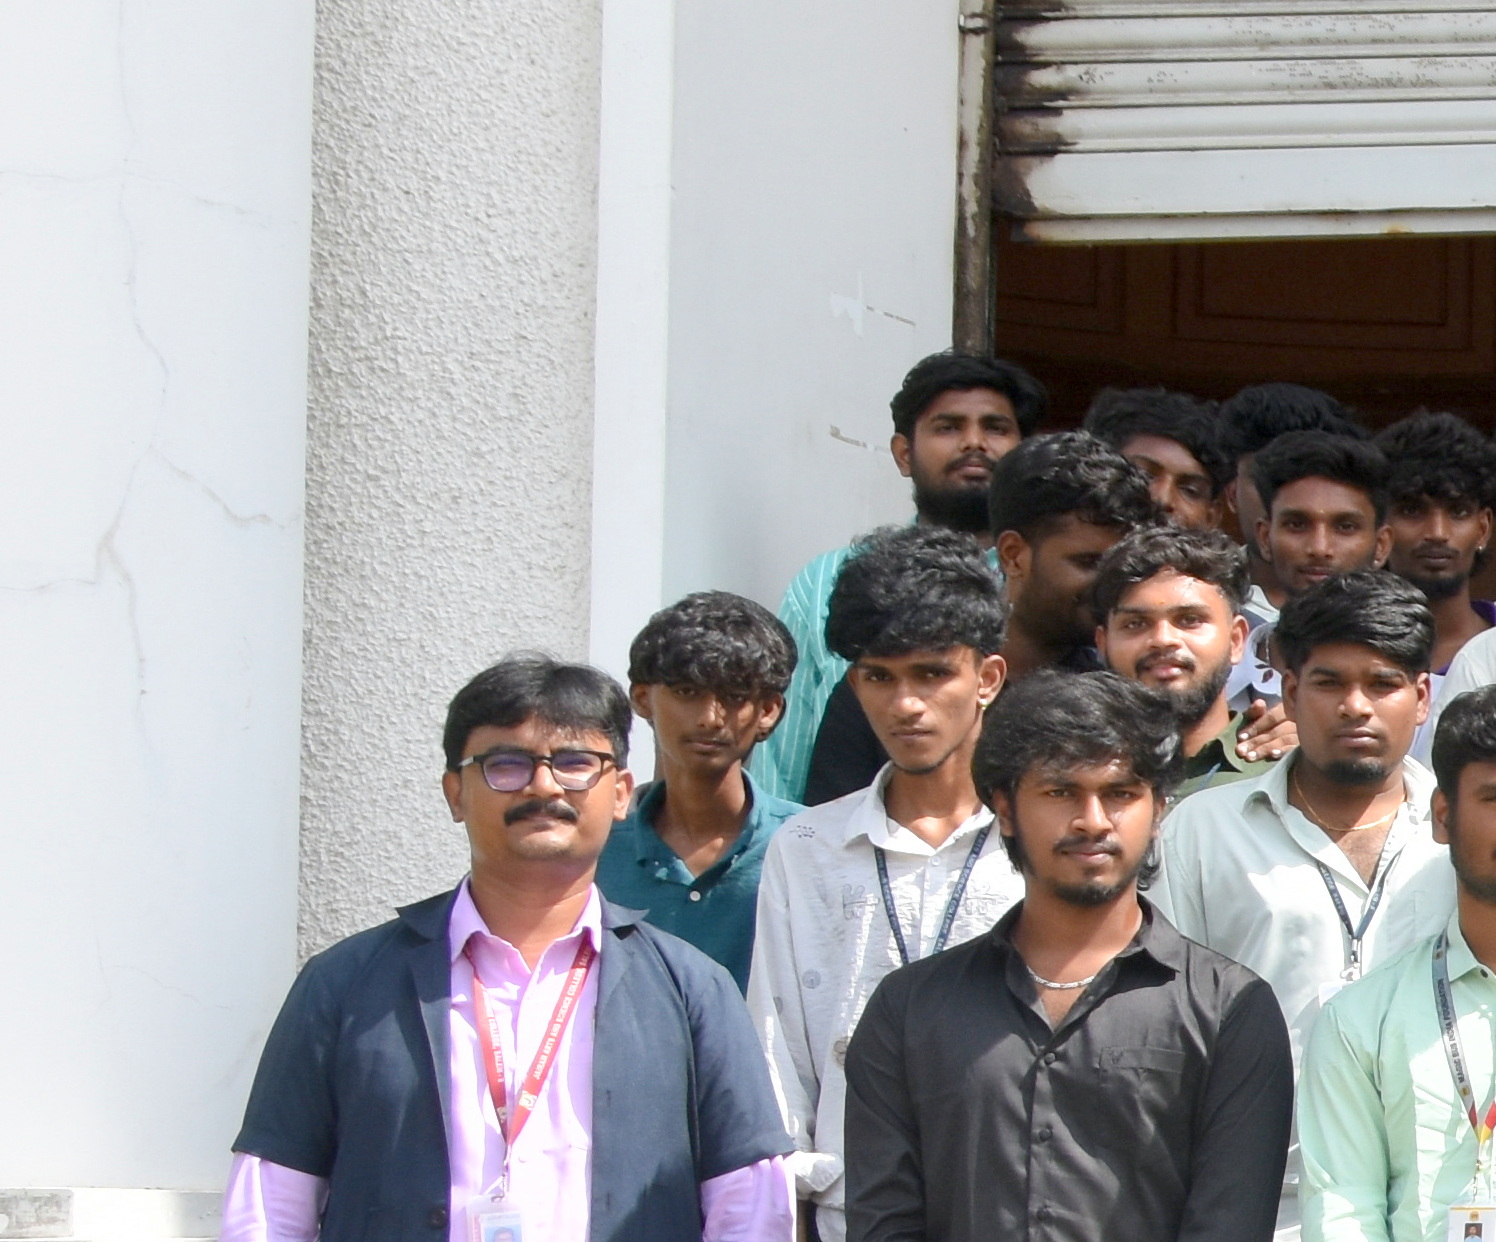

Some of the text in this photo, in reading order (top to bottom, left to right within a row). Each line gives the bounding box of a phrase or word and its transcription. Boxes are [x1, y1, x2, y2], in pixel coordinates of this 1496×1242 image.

[1437, 978, 1451, 1020] FOUNDATION
[1444, 1020, 1455, 1041] INDIA
[1453, 1058, 1465, 1083] MAGIC
